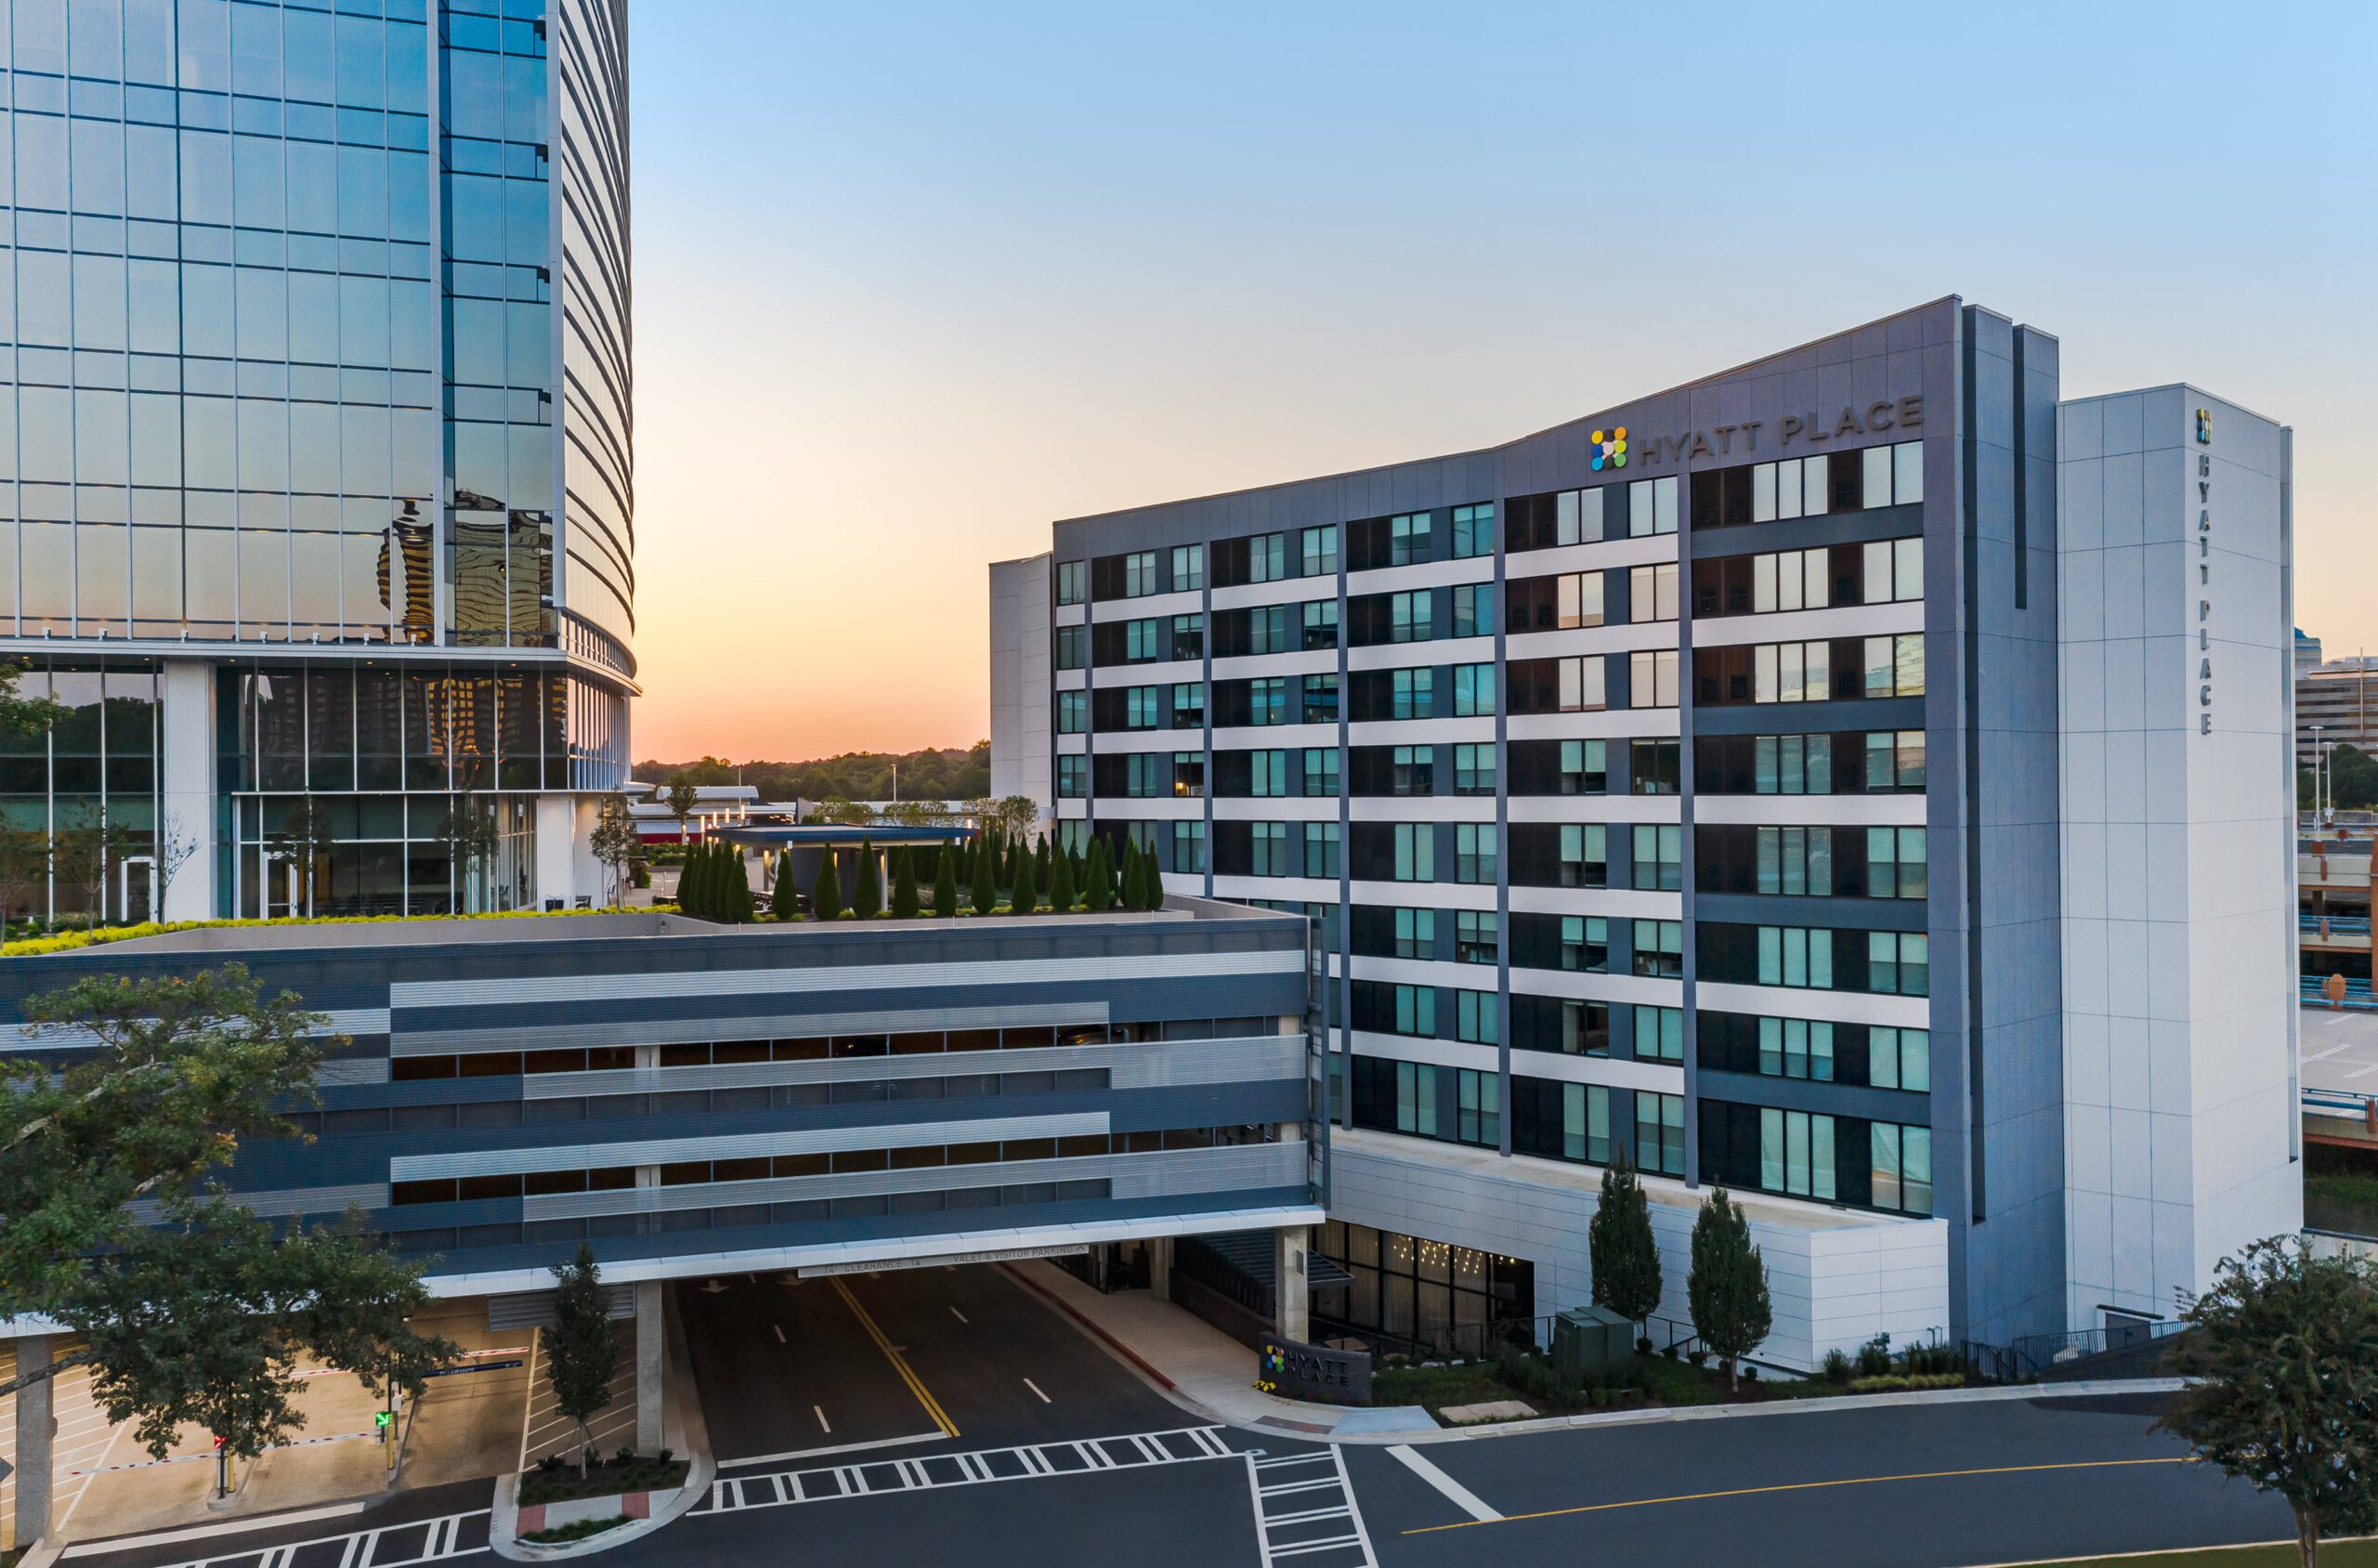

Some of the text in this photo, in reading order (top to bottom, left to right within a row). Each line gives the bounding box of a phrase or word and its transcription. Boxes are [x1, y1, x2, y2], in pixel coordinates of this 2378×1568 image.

[1639, 395, 1924, 464] HYATT PLACE
[2199, 454, 2212, 735] HYATT PLACE
[994, 1250, 1028, 1259] VISITOR
[1032, 1246, 1072, 1257] PARKING
[844, 1261, 903, 1273] CLEARANCE
[1287, 1352, 1349, 1374] HYATT
[1287, 1365, 1350, 1387] PLACE
